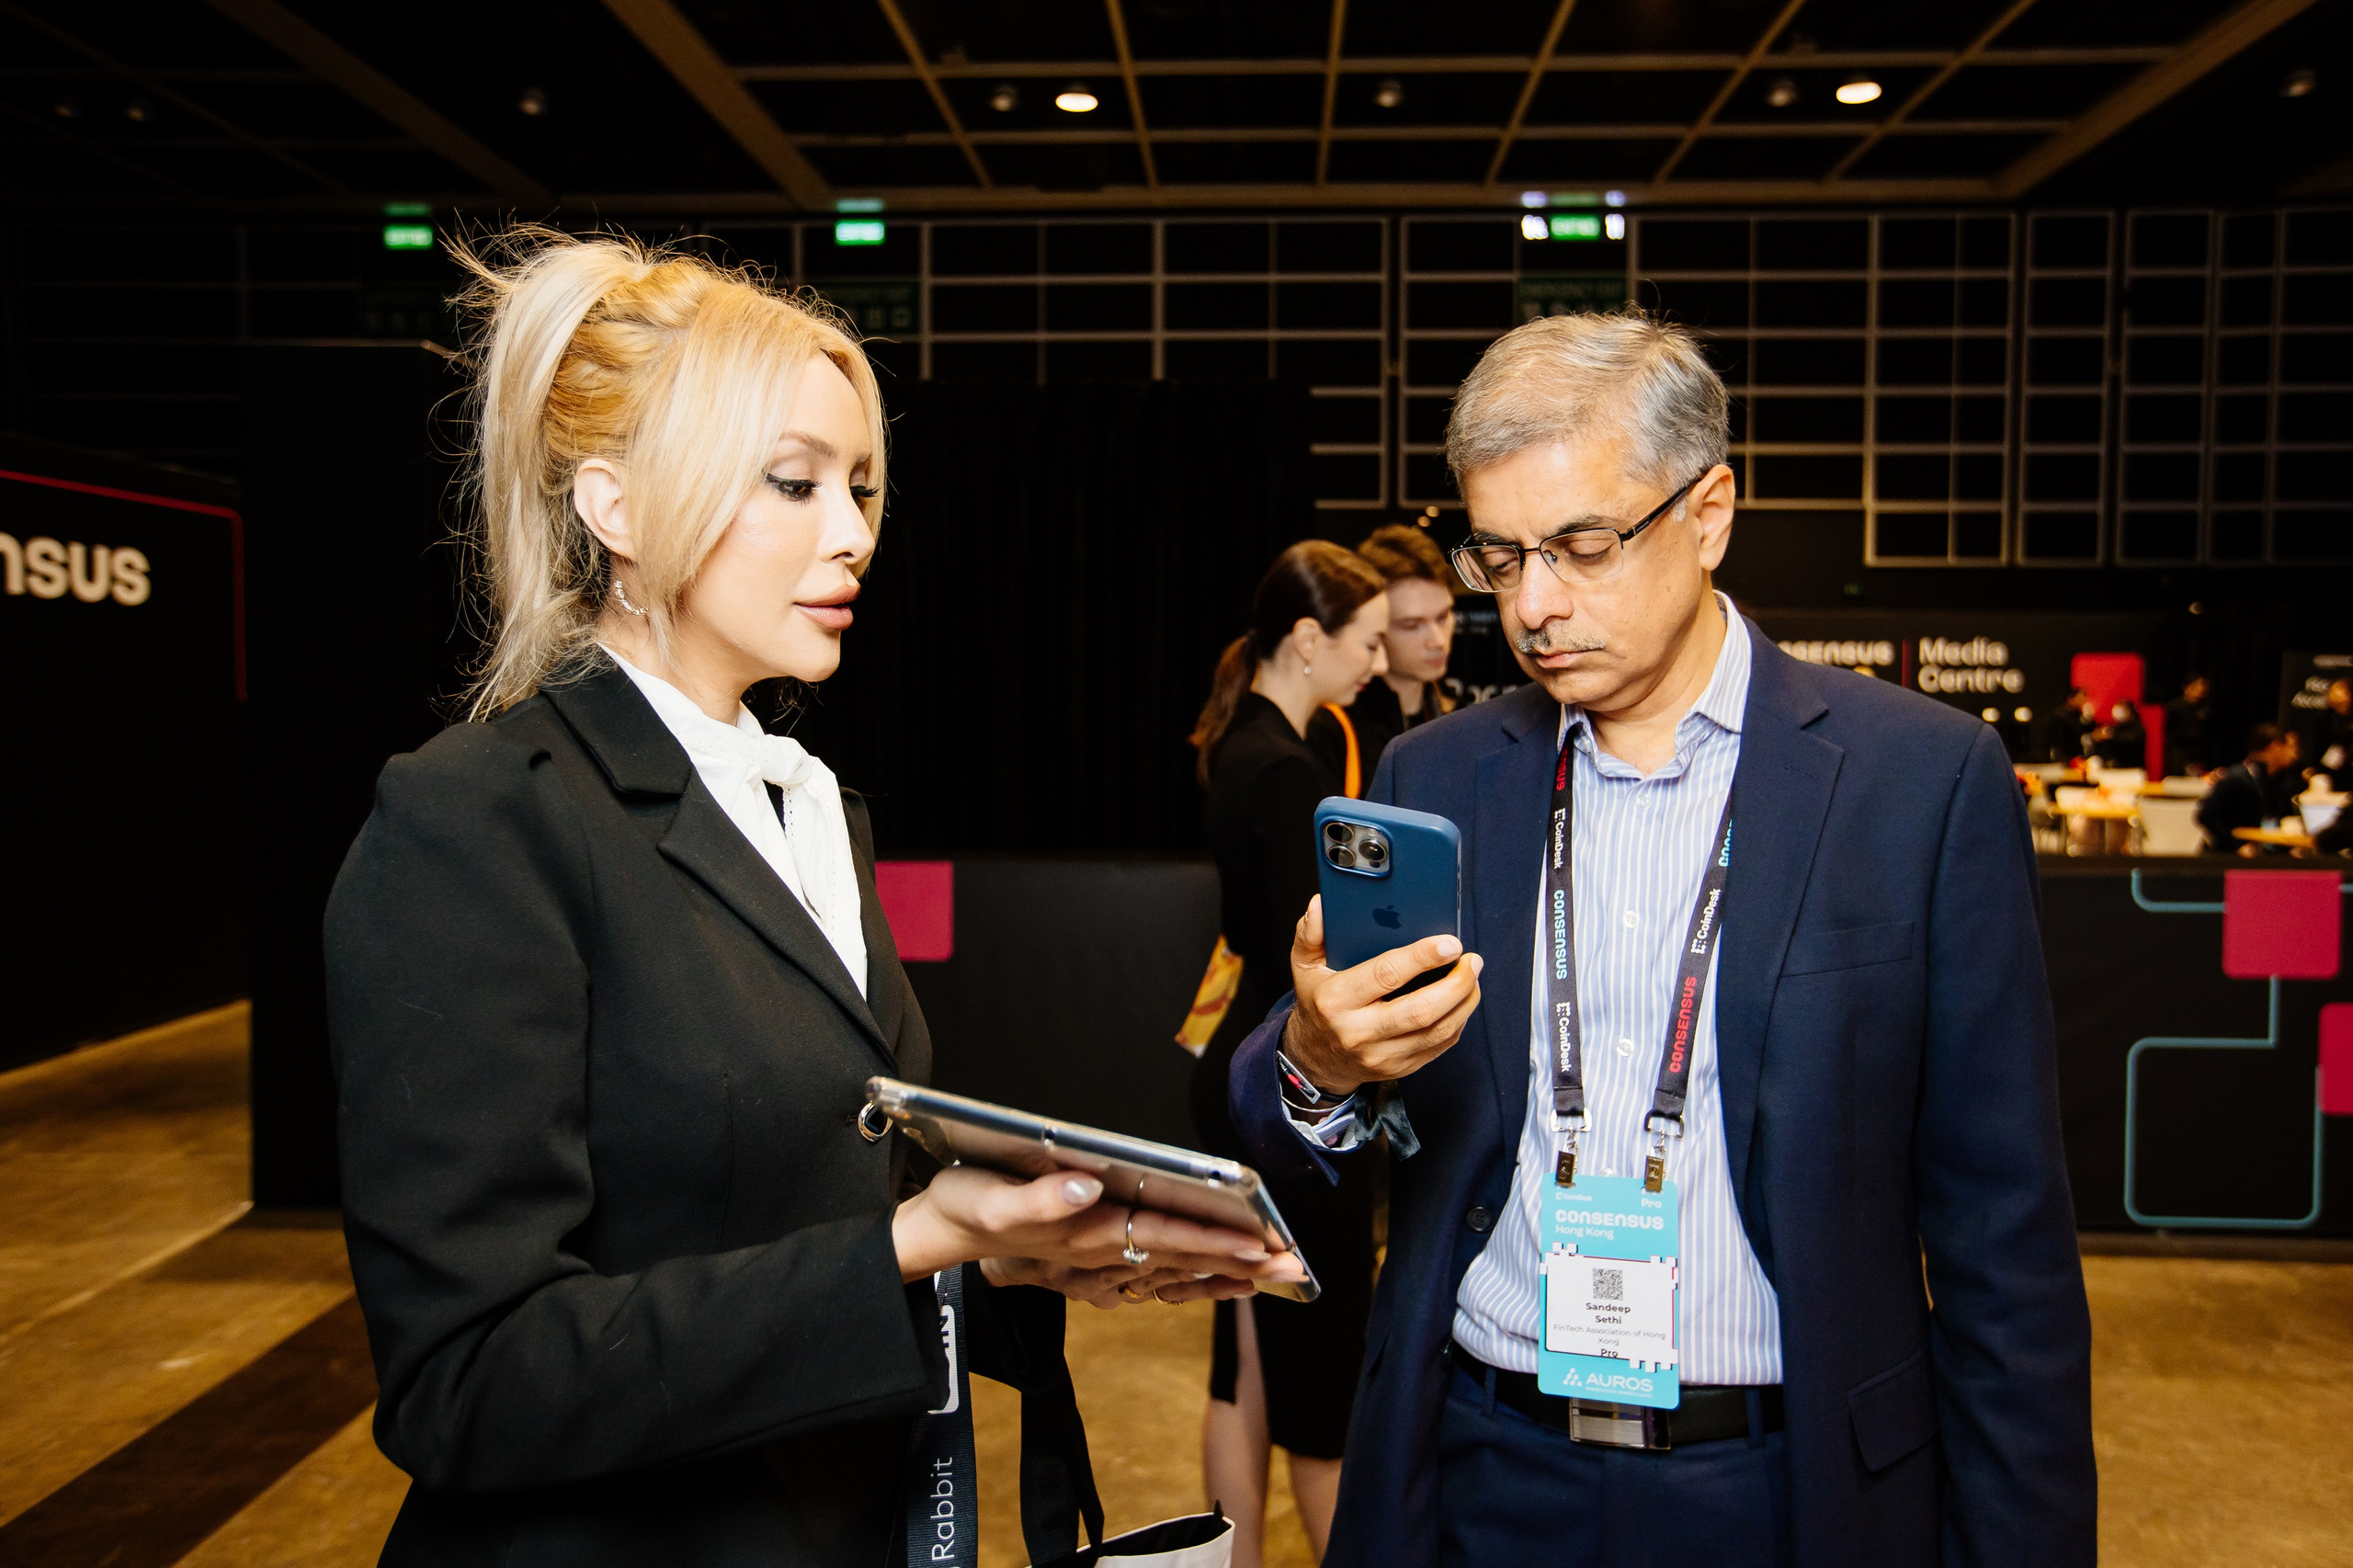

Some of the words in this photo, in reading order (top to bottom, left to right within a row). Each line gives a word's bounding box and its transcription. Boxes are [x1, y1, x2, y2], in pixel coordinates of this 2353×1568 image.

[1919, 637, 2008, 666] Media
[1918, 664, 2025, 694] Centre
[1553, 821, 1564, 869] CoinDesk
[1697, 887, 1722, 940] CoinDesk
[1558, 1016, 1571, 1073] CoinDesk
[1641, 1198, 1662, 1210] Pro
[1555, 1224, 1584, 1238] Hong
[1586, 1226, 1615, 1241] Kong
[1586, 1302, 1631, 1314] Sandeep
[1595, 1315, 1622, 1324] Sethi
[1553, 1324, 1584, 1333] FinTech
[1586, 1326, 1631, 1336] Association
[1643, 1331, 1665, 1341] Hong
[1597, 1336, 1620, 1346] Kong
[1600, 1348, 1619, 1358] Pro
[1586, 1372, 1654, 1392] AUROS
[930, 1457, 955, 1562] Rabbit
